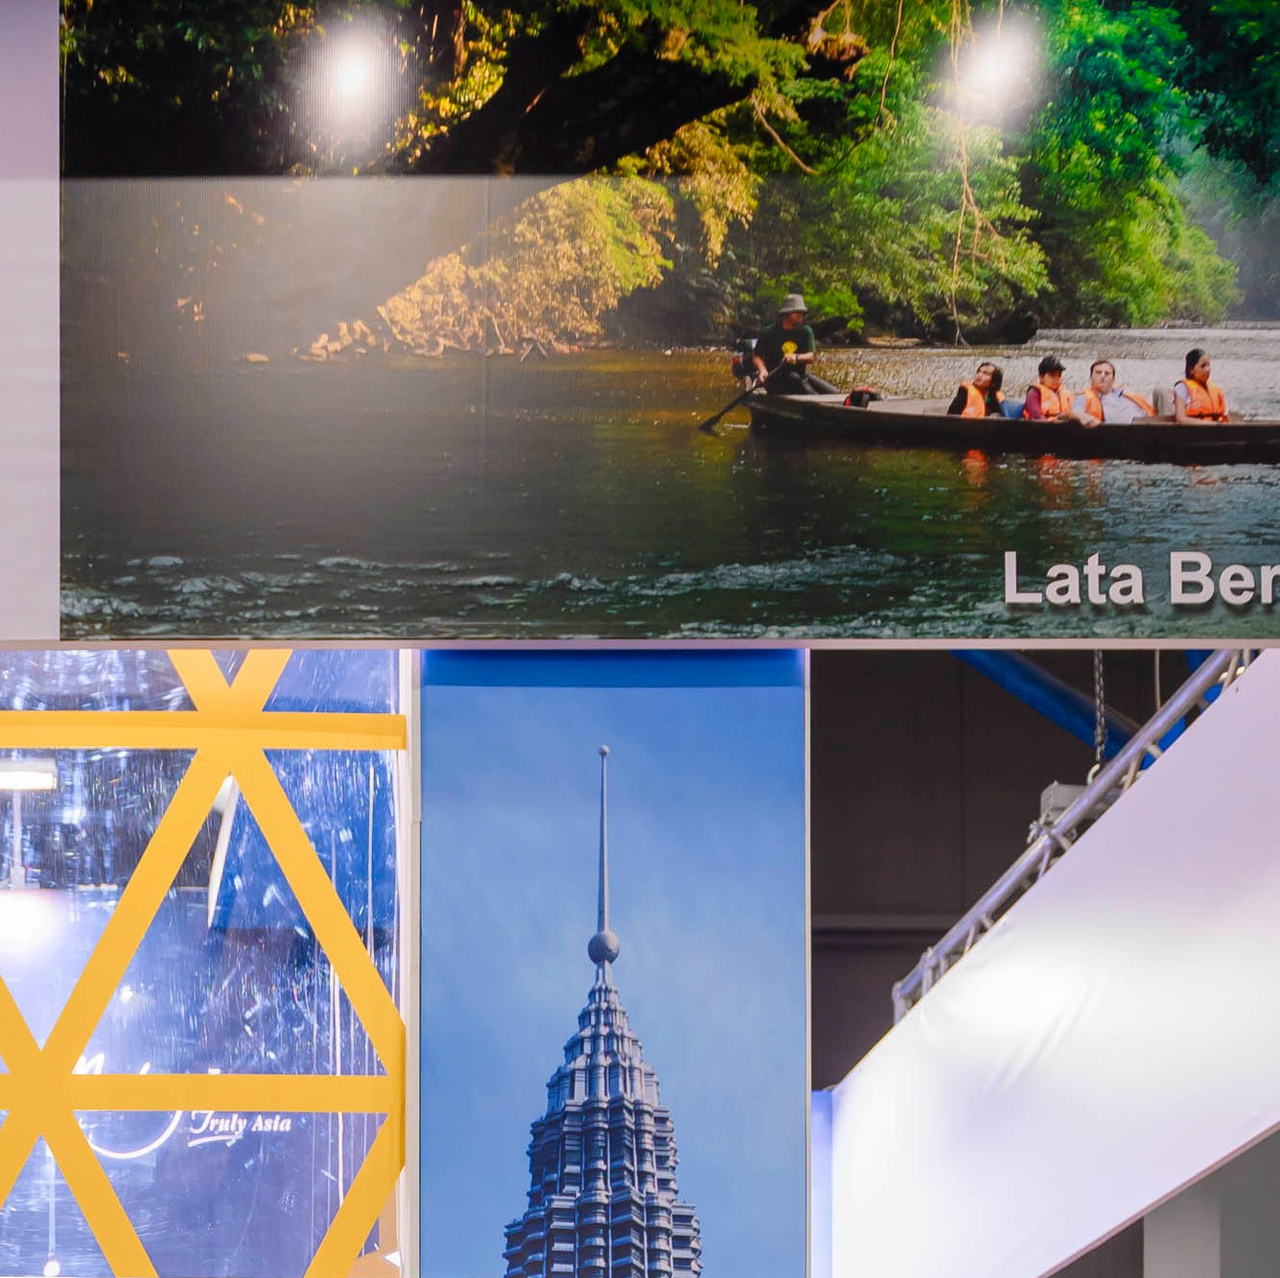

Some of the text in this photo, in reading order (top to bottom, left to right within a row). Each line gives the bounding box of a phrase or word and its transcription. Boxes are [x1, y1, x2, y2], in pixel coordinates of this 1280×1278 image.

[1004, 551, 1145, 605] Lata
[190, 1110, 292, 1134] Truly Asia
